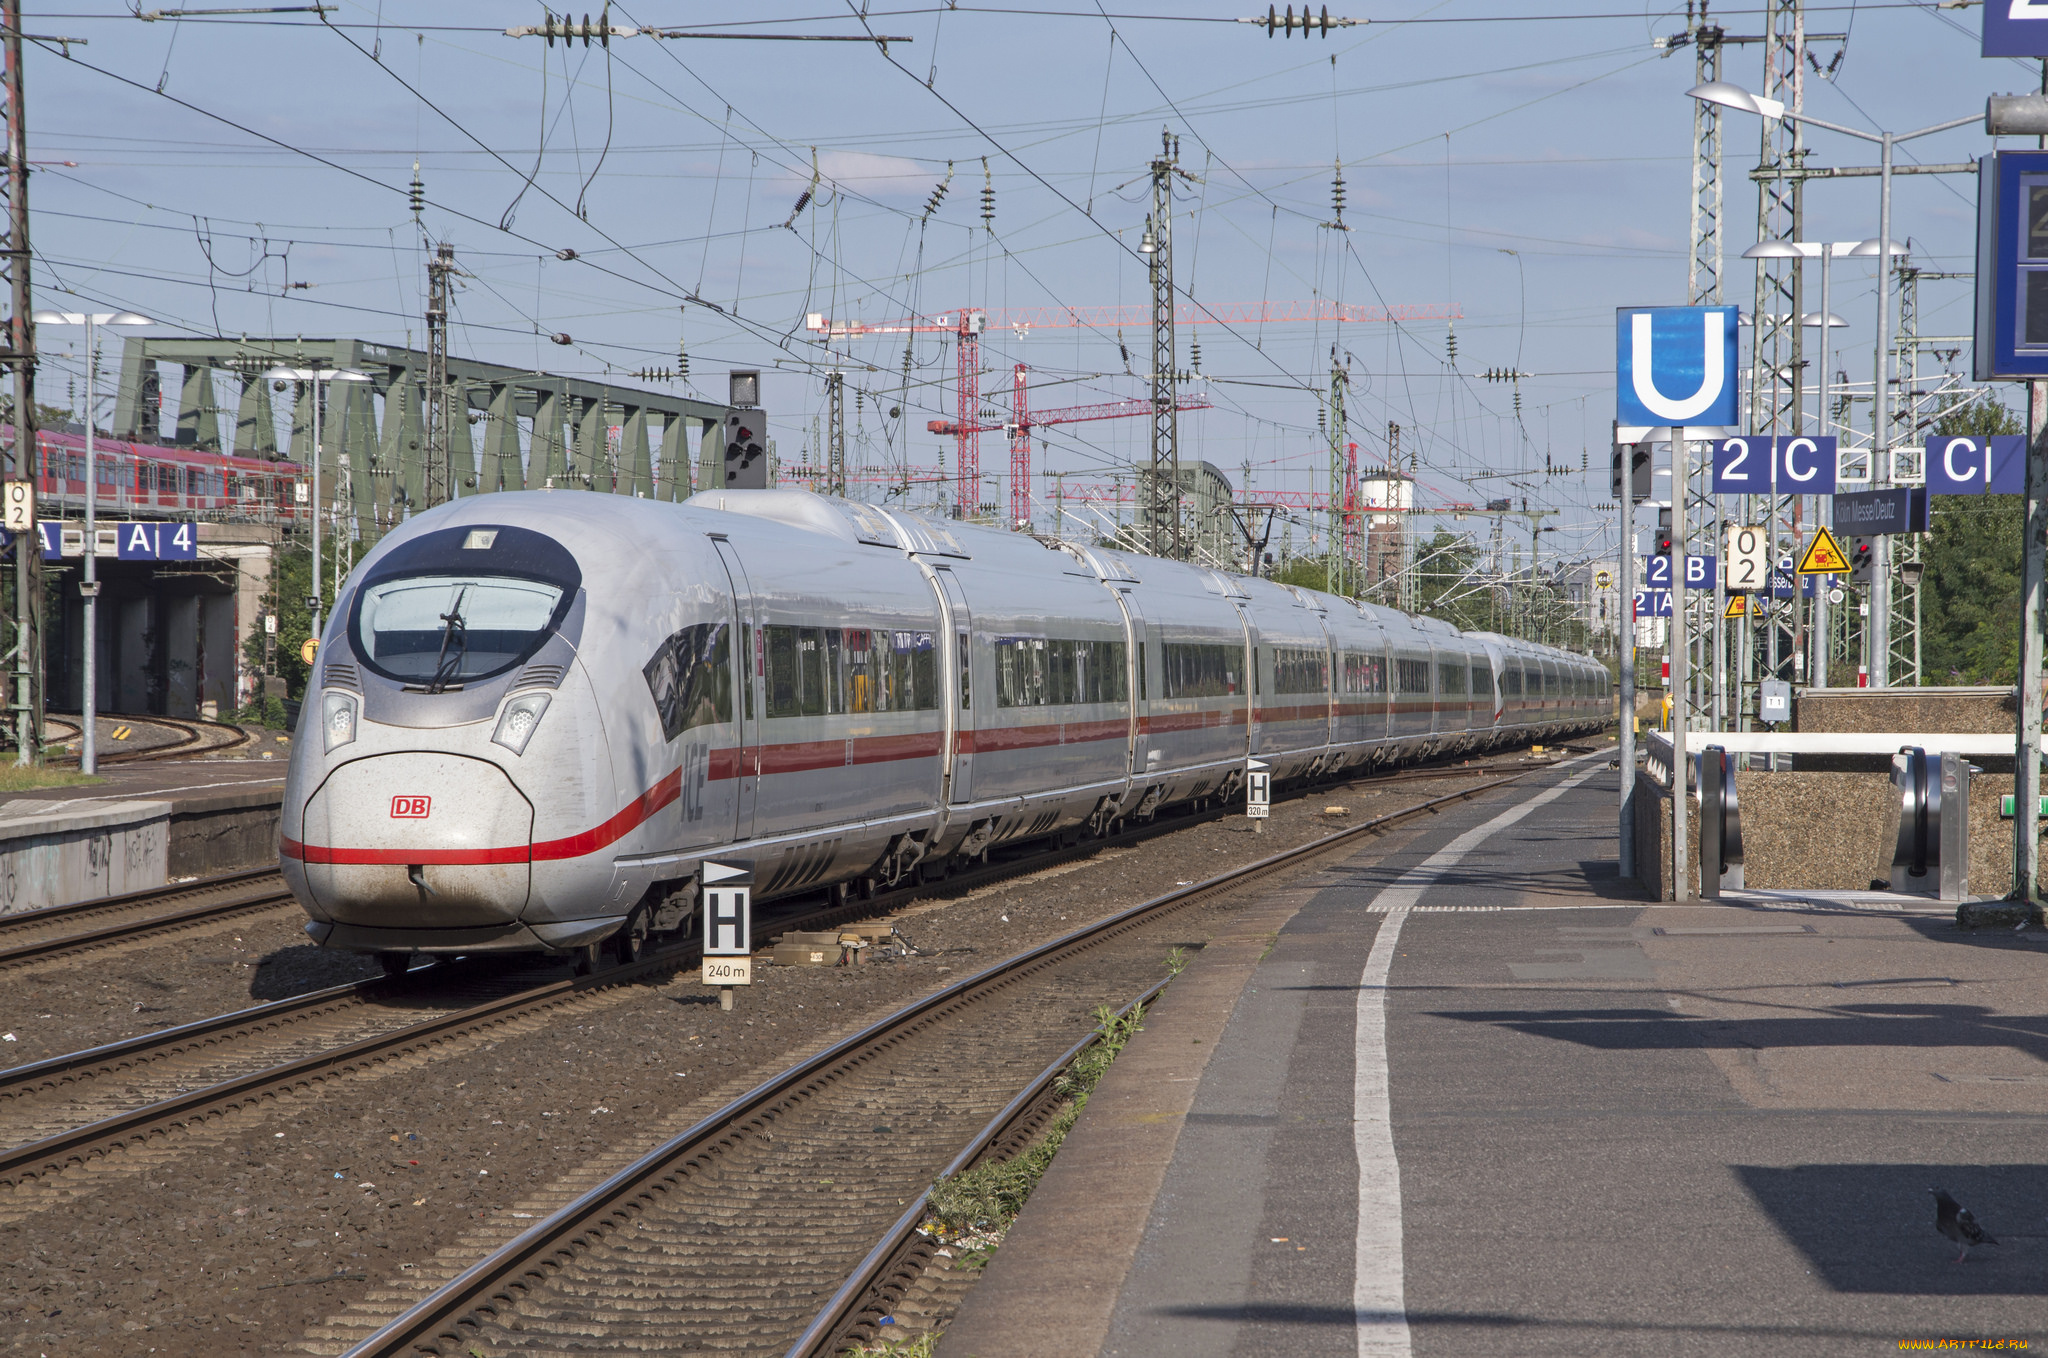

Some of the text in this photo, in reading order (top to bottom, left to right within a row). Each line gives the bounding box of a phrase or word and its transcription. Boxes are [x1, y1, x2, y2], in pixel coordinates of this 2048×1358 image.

[1632, 312, 1724, 420] U
[1721, 438, 1818, 482] 2 C
[1943, 438, 1978, 482] C
[12, 486, 24, 503] 0
[13, 507, 24, 523] 2
[1835, 498, 1895, 523] Köln Messe/Deutz
[128, 524, 191, 551] A 4
[1738, 531, 1755, 554] 0
[1652, 556, 1705, 581] 2 B
[1739, 559, 1755, 583] 2
[1636, 592, 1673, 611] 2 A
[681, 743, 707, 823] ICE
[1250, 775, 1267, 801] H
[396, 799, 425, 814] DB
[1249, 807, 1261, 815] 320
[710, 893, 744, 949] H
[709, 965, 745, 977] 240 m
